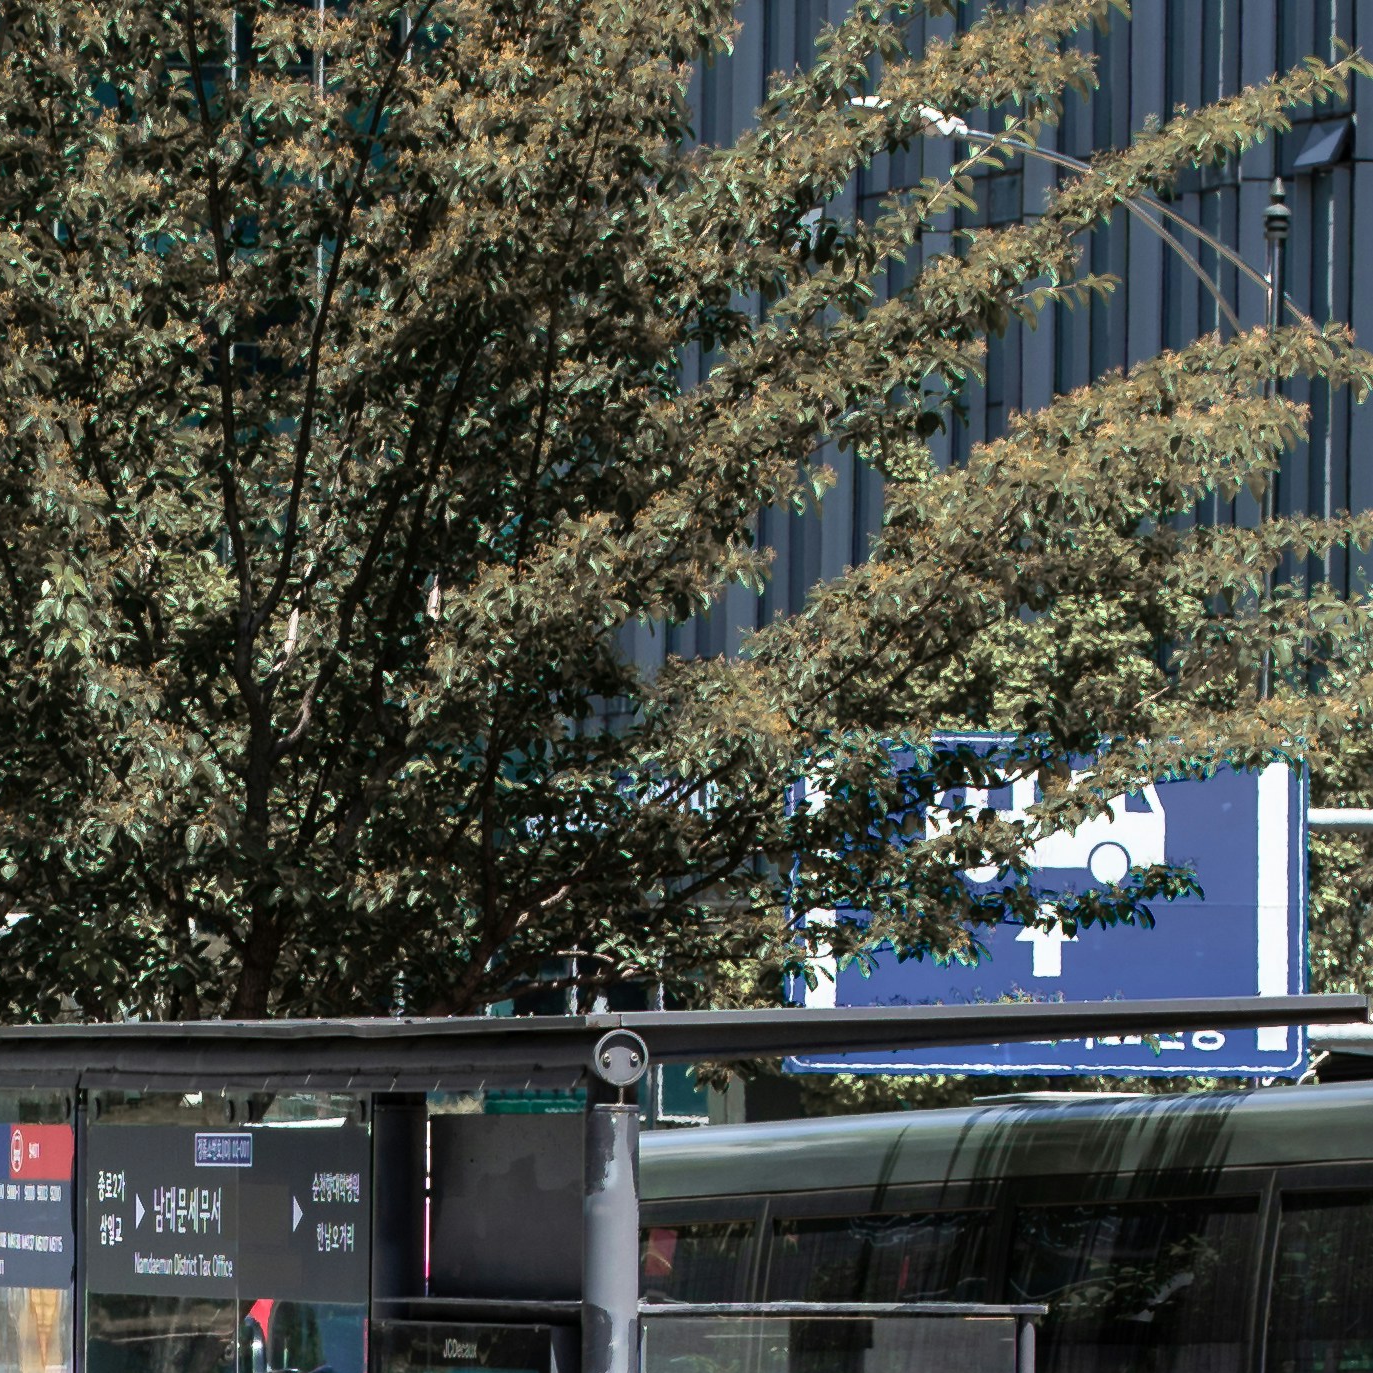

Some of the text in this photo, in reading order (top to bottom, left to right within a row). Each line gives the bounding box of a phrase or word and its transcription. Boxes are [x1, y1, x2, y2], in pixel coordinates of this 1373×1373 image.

[98, 1170, 125, 1202] 종로2가
[153, 1186, 221, 1235] 남대문세무서
[317, 1222, 355, 1252] 한남오거리
[174, 1252, 198, 1277] District
[199, 1253, 211, 1277] Tax
[212, 1254, 233, 1278] Office
[443, 1338, 478, 1359] JCDecaux
